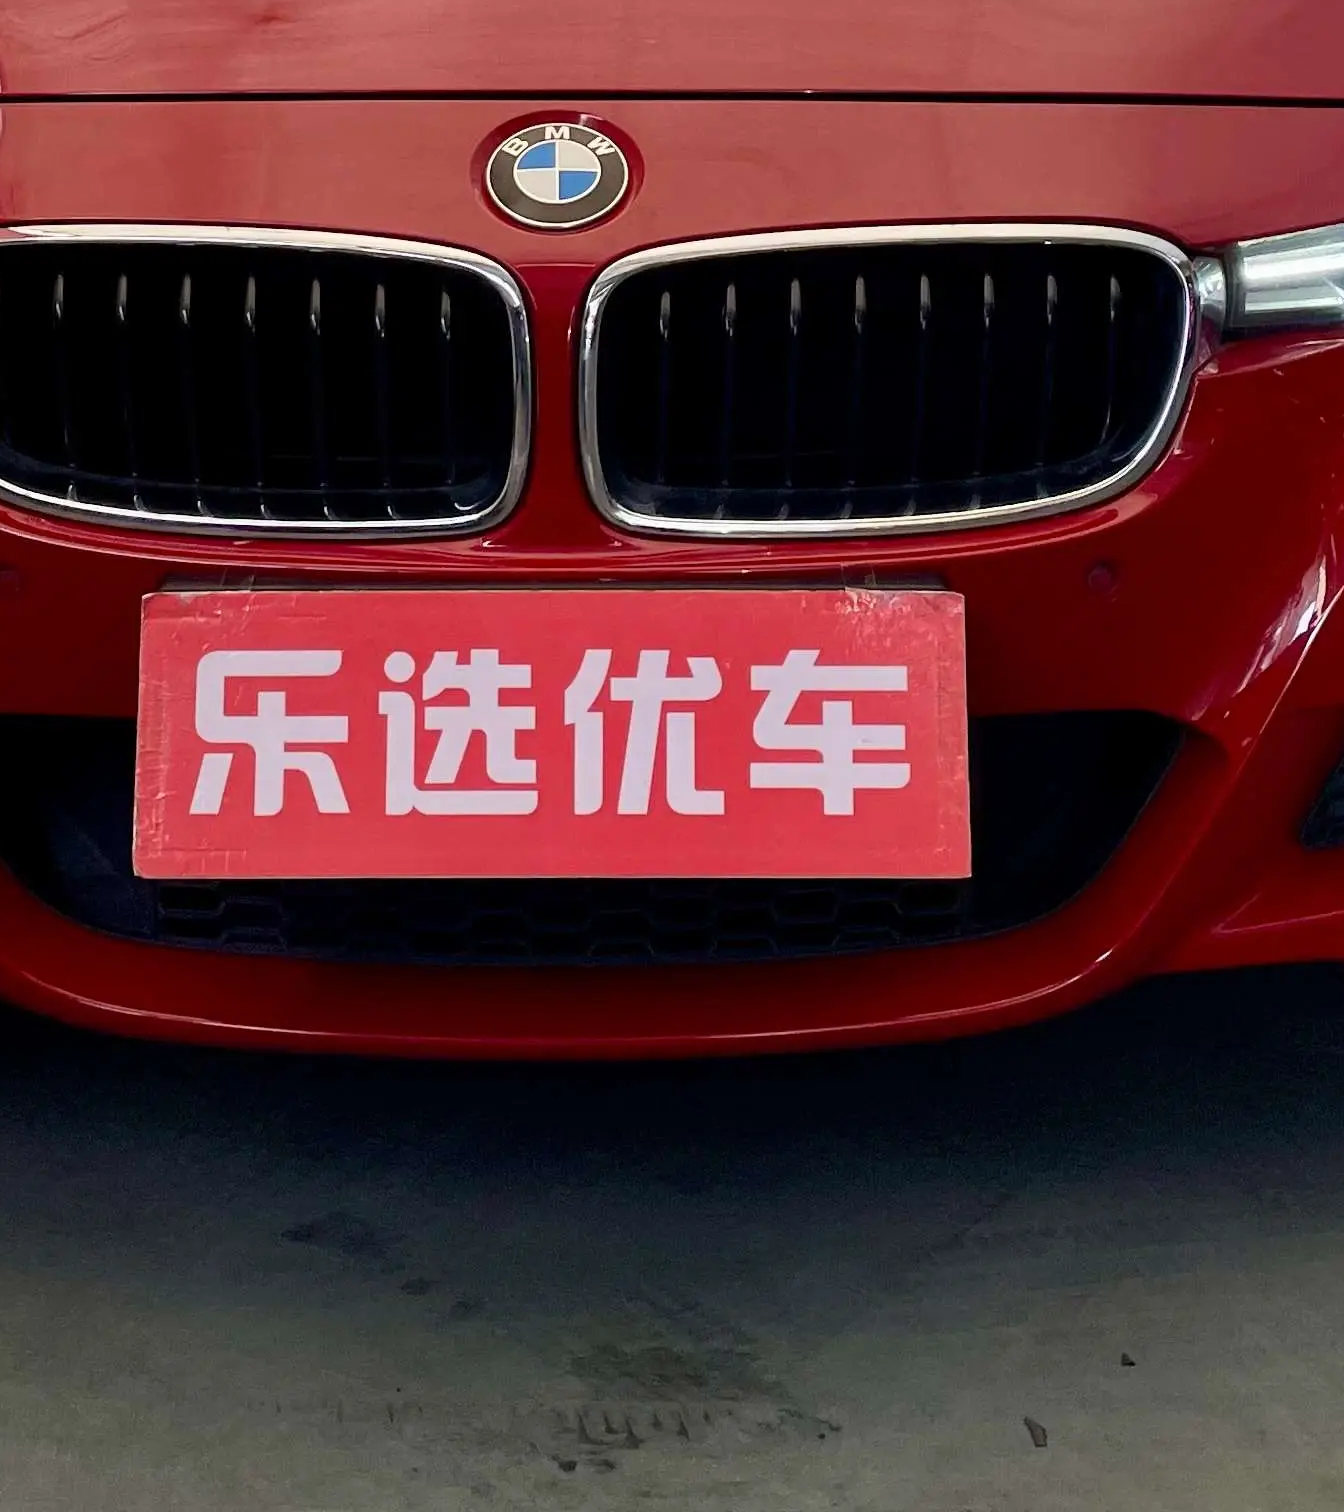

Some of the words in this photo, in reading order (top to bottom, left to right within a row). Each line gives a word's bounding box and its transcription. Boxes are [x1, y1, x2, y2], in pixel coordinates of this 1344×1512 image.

[501, 125, 616, 157] BMW
[189, 648, 912, 817] 乐选优车
